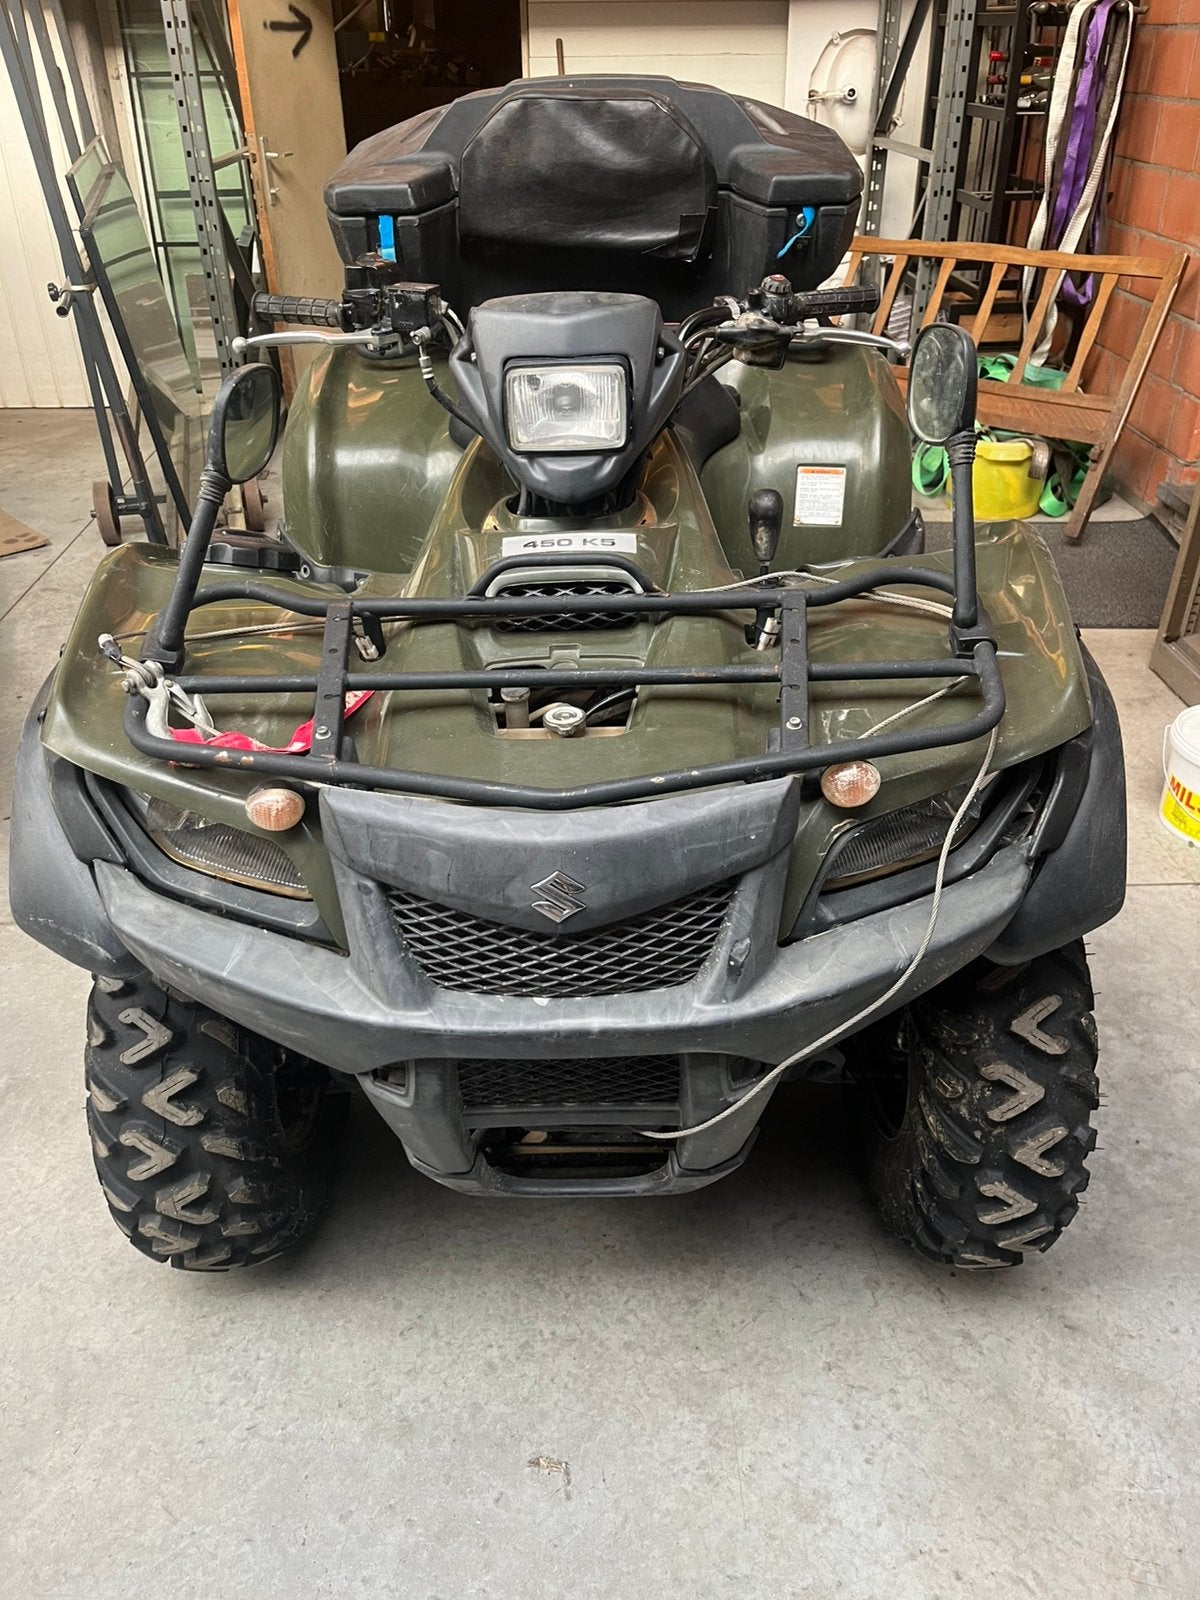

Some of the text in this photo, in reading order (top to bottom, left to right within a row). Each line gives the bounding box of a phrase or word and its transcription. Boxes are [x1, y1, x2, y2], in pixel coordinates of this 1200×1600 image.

[523, 538, 616, 549] 450 K5
[1169, 776, 1200, 813] MIL
